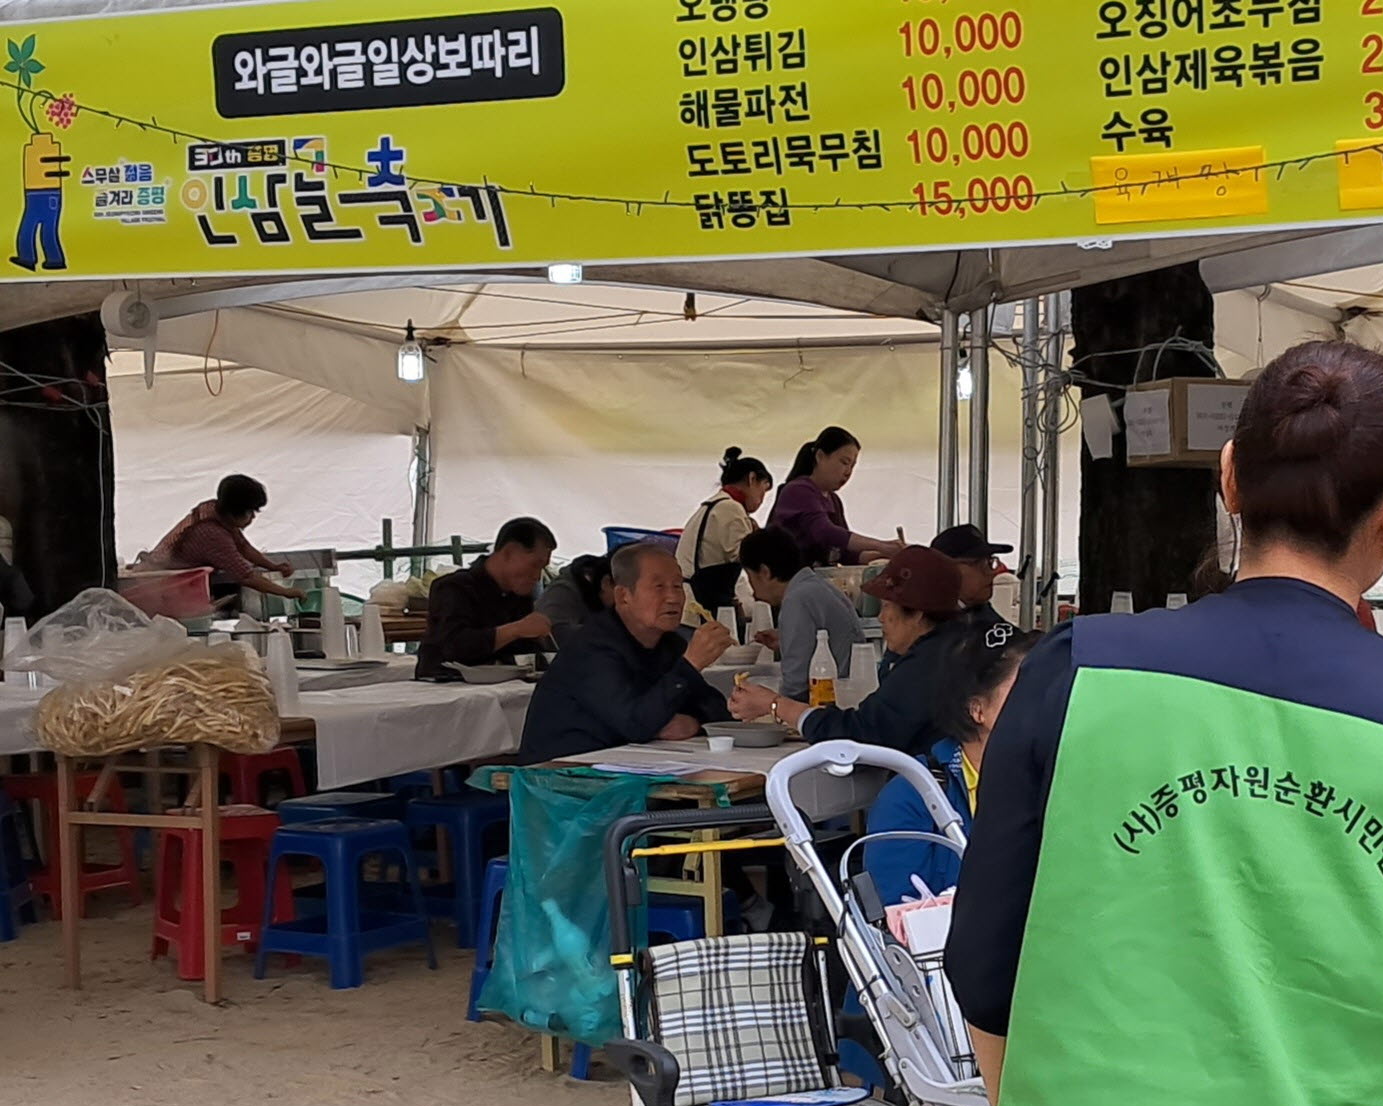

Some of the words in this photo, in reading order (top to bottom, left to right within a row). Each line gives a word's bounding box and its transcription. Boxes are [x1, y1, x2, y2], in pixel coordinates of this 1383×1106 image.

[679, 28, 806, 76] 인삼튀김
[900, 11, 1022, 58] 10,000
[233, 26, 540, 94] 와글와글일상보따리
[1099, 39, 1324, 97] 인삼제육볶음
[679, 82, 810, 128] 해물파전
[903, 66, 1025, 112] 10,000
[687, 129, 882, 177] 도토리묵무침
[907, 121, 1029, 166] 10,000
[1101, 109, 1174, 152] 수육
[137, 186, 165, 205] 증평
[694, 188, 791, 229] 닭똥집
[912, 175, 1034, 218] 15,000
